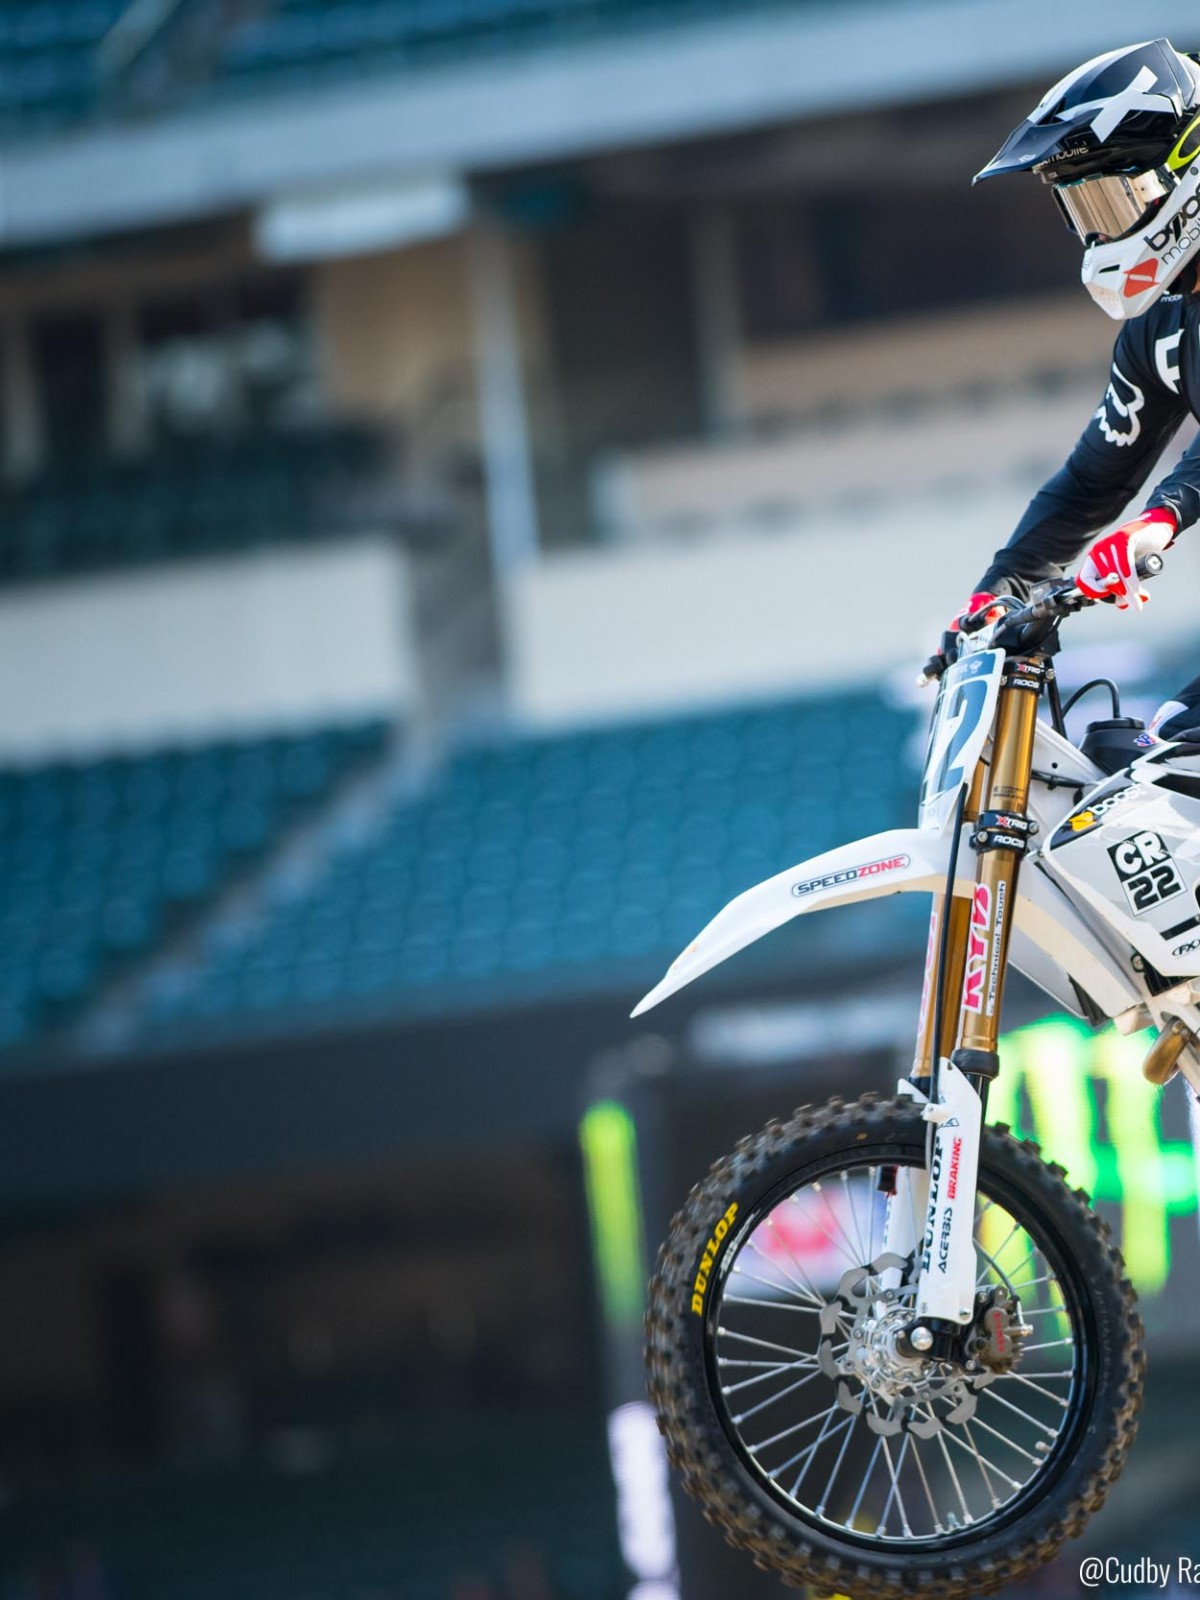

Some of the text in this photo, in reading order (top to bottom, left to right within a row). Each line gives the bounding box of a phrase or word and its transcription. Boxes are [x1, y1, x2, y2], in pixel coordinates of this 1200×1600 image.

[1091, 782, 1144, 817] boost
[993, 834, 1026, 848] ROCS
[1115, 830, 1168, 875] CR
[797, 857, 906, 895] SPEEDZONE
[1129, 865, 1182, 911] 22
[962, 882, 991, 1016] KYB
[988, 932, 1002, 1003] Technical
[996, 882, 1006, 927] Touch
[947, 1136, 963, 1201] BRAKING
[922, 1135, 944, 1275] DUNLOP
[691, 1201, 738, 1317] DUNLOP
